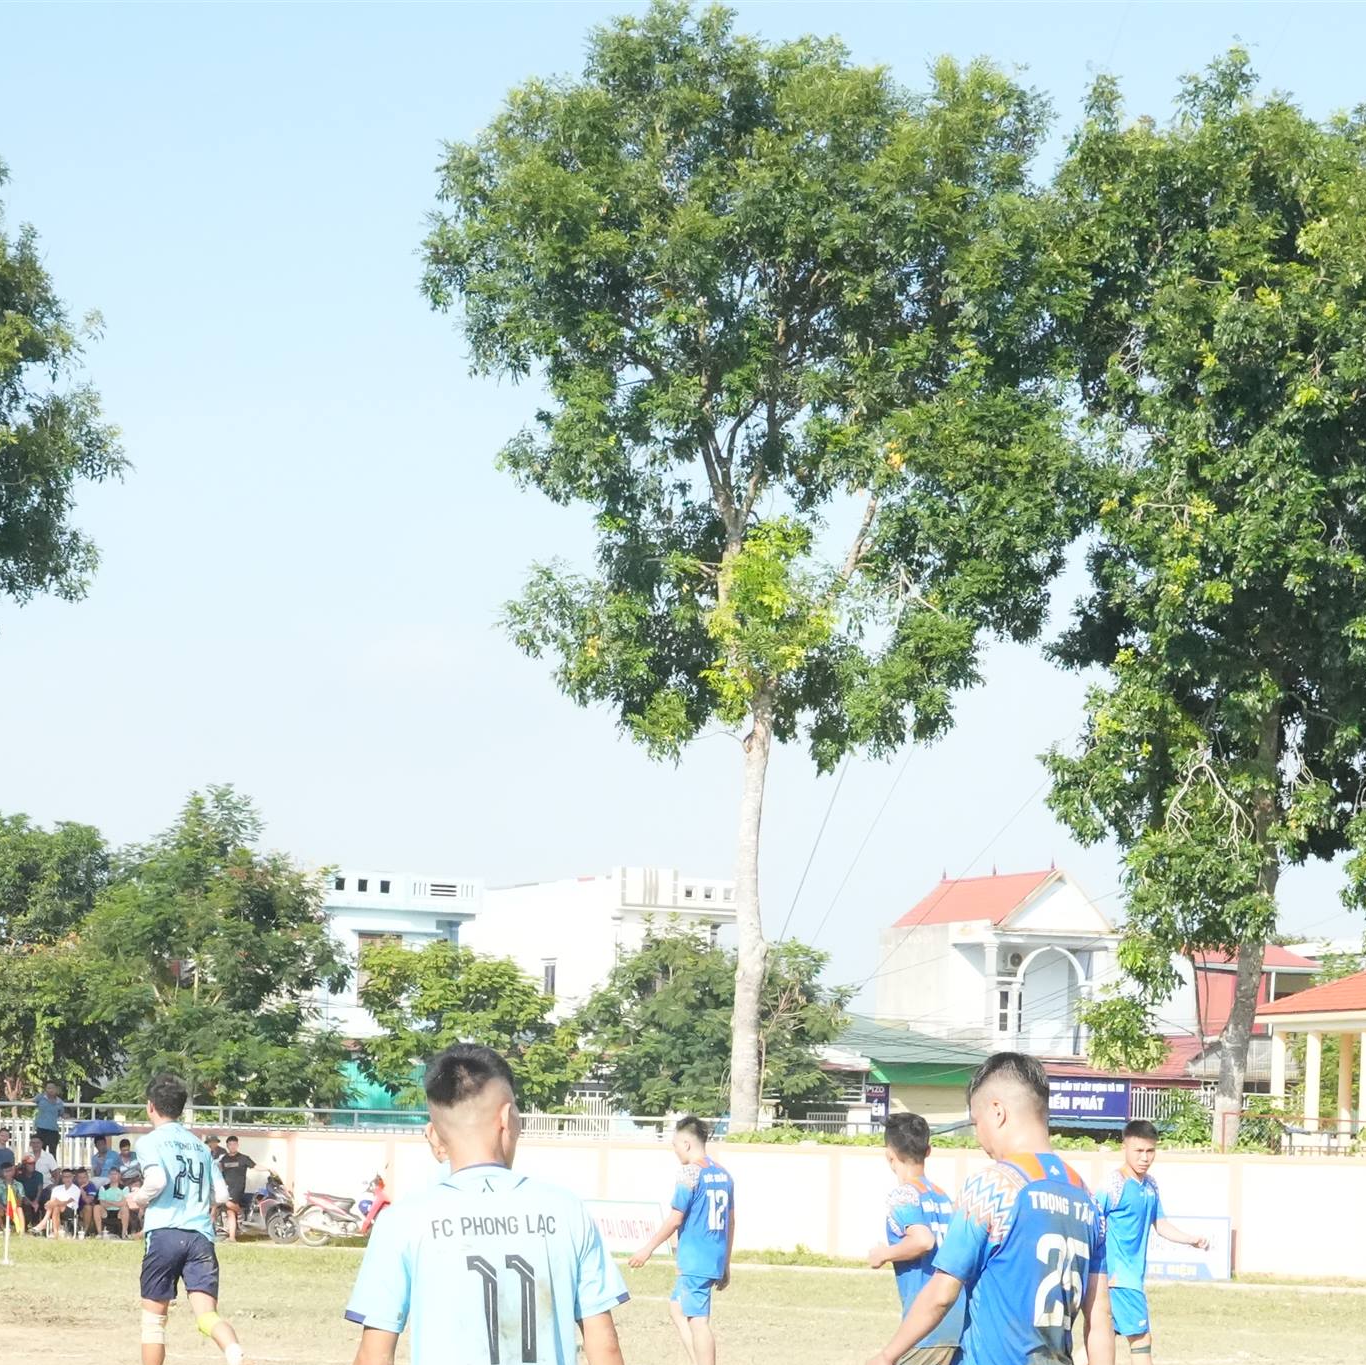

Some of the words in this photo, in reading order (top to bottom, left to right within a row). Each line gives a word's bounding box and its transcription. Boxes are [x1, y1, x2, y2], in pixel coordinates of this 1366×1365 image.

[1048, 1093, 1070, 1109] IẾN
[1072, 1095, 1105, 1110] PHÁT
[172, 1154, 205, 1203] 24
[706, 1189, 729, 1230] 12
[1027, 1190, 1070, 1215] TRỌNG
[431, 1219, 454, 1240] FC
[460, 1215, 519, 1236] PHONG
[525, 1213, 556, 1238] LẠC
[1034, 1233, 1090, 1331] 25
[466, 1254, 537, 1365] 11
